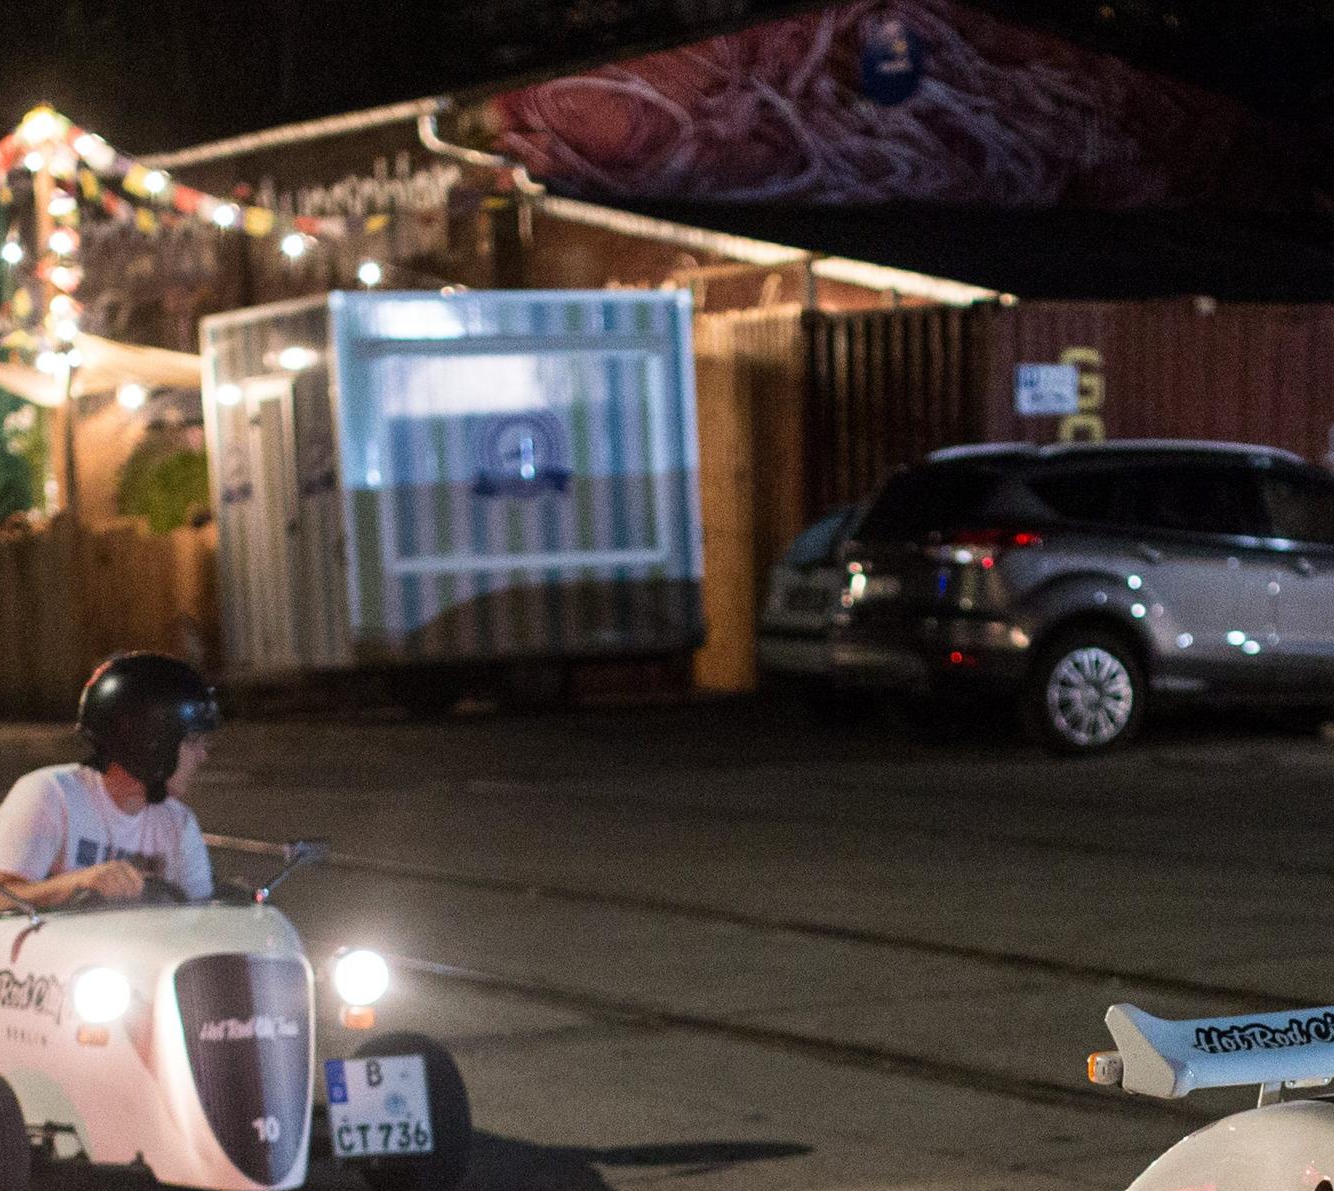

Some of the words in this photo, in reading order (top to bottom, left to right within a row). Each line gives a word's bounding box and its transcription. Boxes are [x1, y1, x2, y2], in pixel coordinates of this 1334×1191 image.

[1198, 1030, 1247, 1053] Hot
[1245, 1021, 1308, 1051] Rod
[367, 1060, 383, 1087] B
[253, 1115, 281, 1143] 10
[337, 1123, 370, 1152] CT
